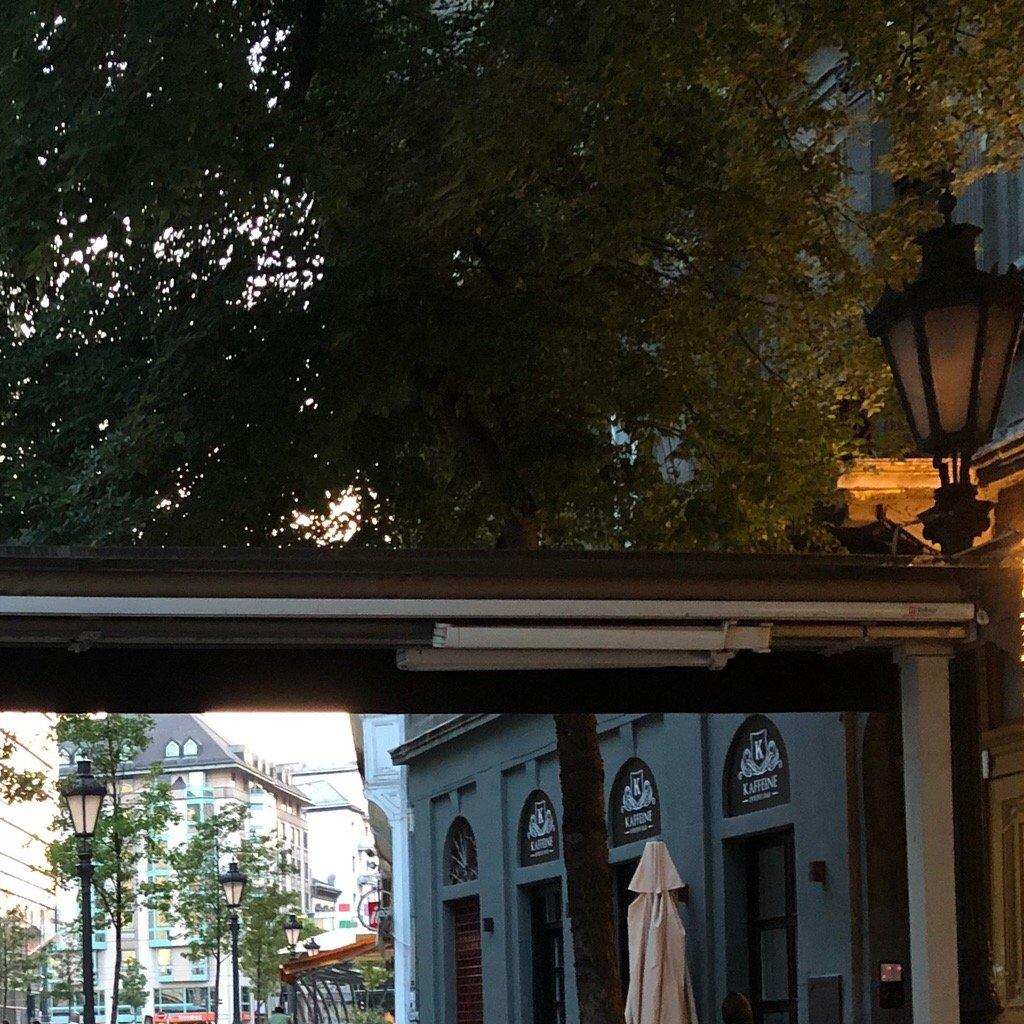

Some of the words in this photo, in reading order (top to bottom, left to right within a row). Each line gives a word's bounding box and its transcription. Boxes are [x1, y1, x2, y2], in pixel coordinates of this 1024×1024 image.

[754, 739, 765, 760] K
[633, 777, 641, 796] K
[742, 775, 778, 796] KAFFEINE
